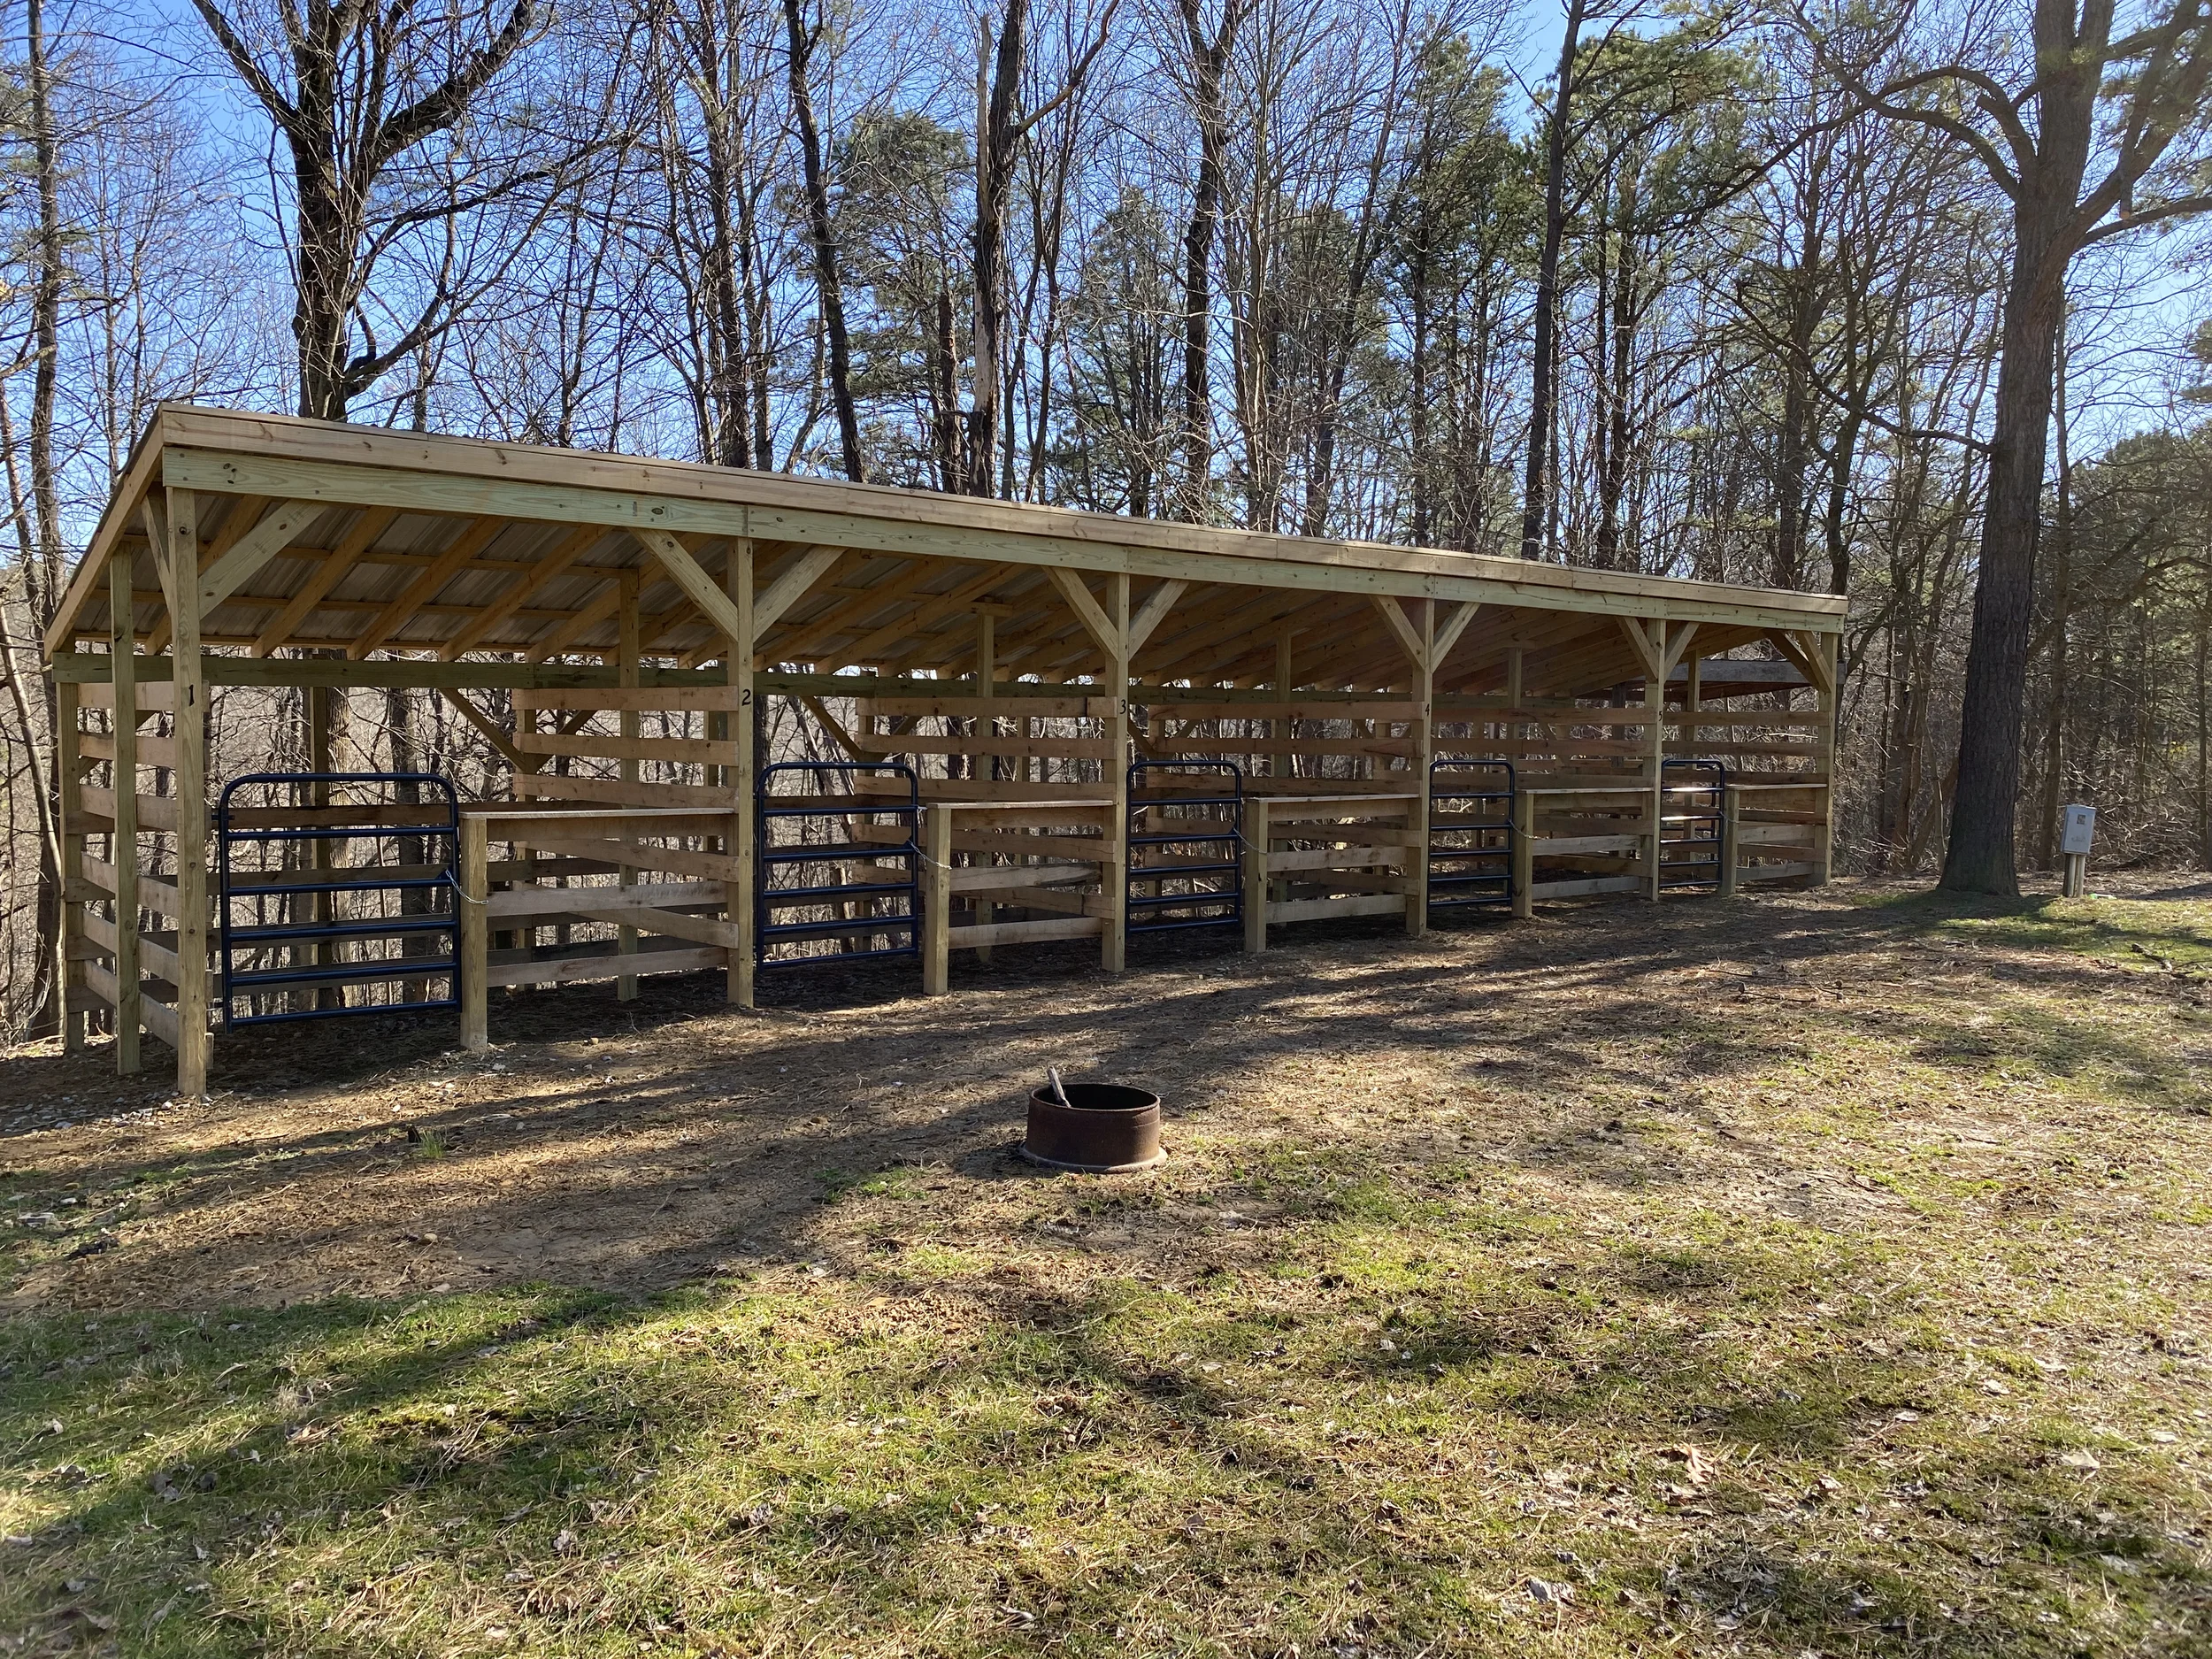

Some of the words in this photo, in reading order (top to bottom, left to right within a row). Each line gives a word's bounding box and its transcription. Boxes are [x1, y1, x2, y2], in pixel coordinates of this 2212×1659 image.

[188, 684, 195, 707] 1
[741, 688, 751, 706] 2
[1119, 698, 1126, 715] 3
[1425, 703, 1430, 717] 4
[1658, 710, 1663, 721] 5
